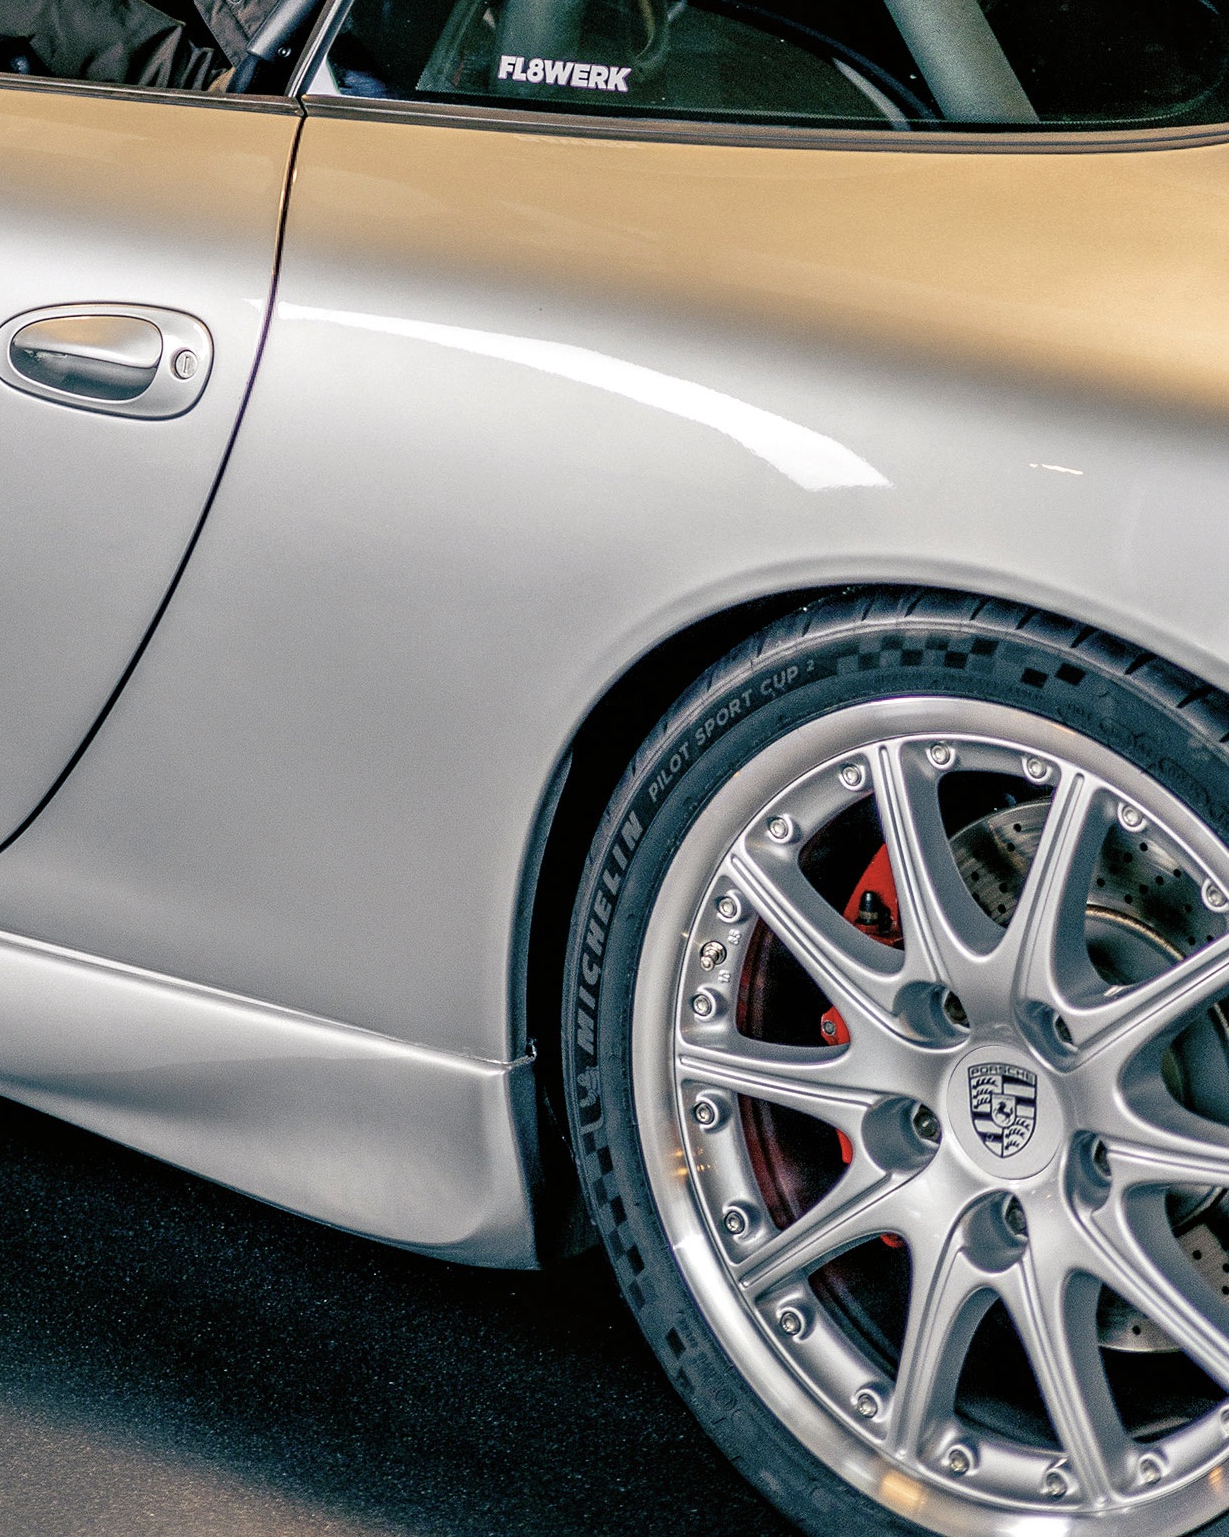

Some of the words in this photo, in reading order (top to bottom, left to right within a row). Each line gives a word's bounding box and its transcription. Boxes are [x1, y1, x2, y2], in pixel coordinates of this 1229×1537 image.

[497, 54, 632, 93] FL8WERK
[576, 810, 644, 1055] MICHELIN
[647, 740, 691, 804] PILOT
[694, 687, 754, 747] SPORT
[759, 664, 799, 698] CUP
[970, 1064, 1034, 1084] PORSCHE
